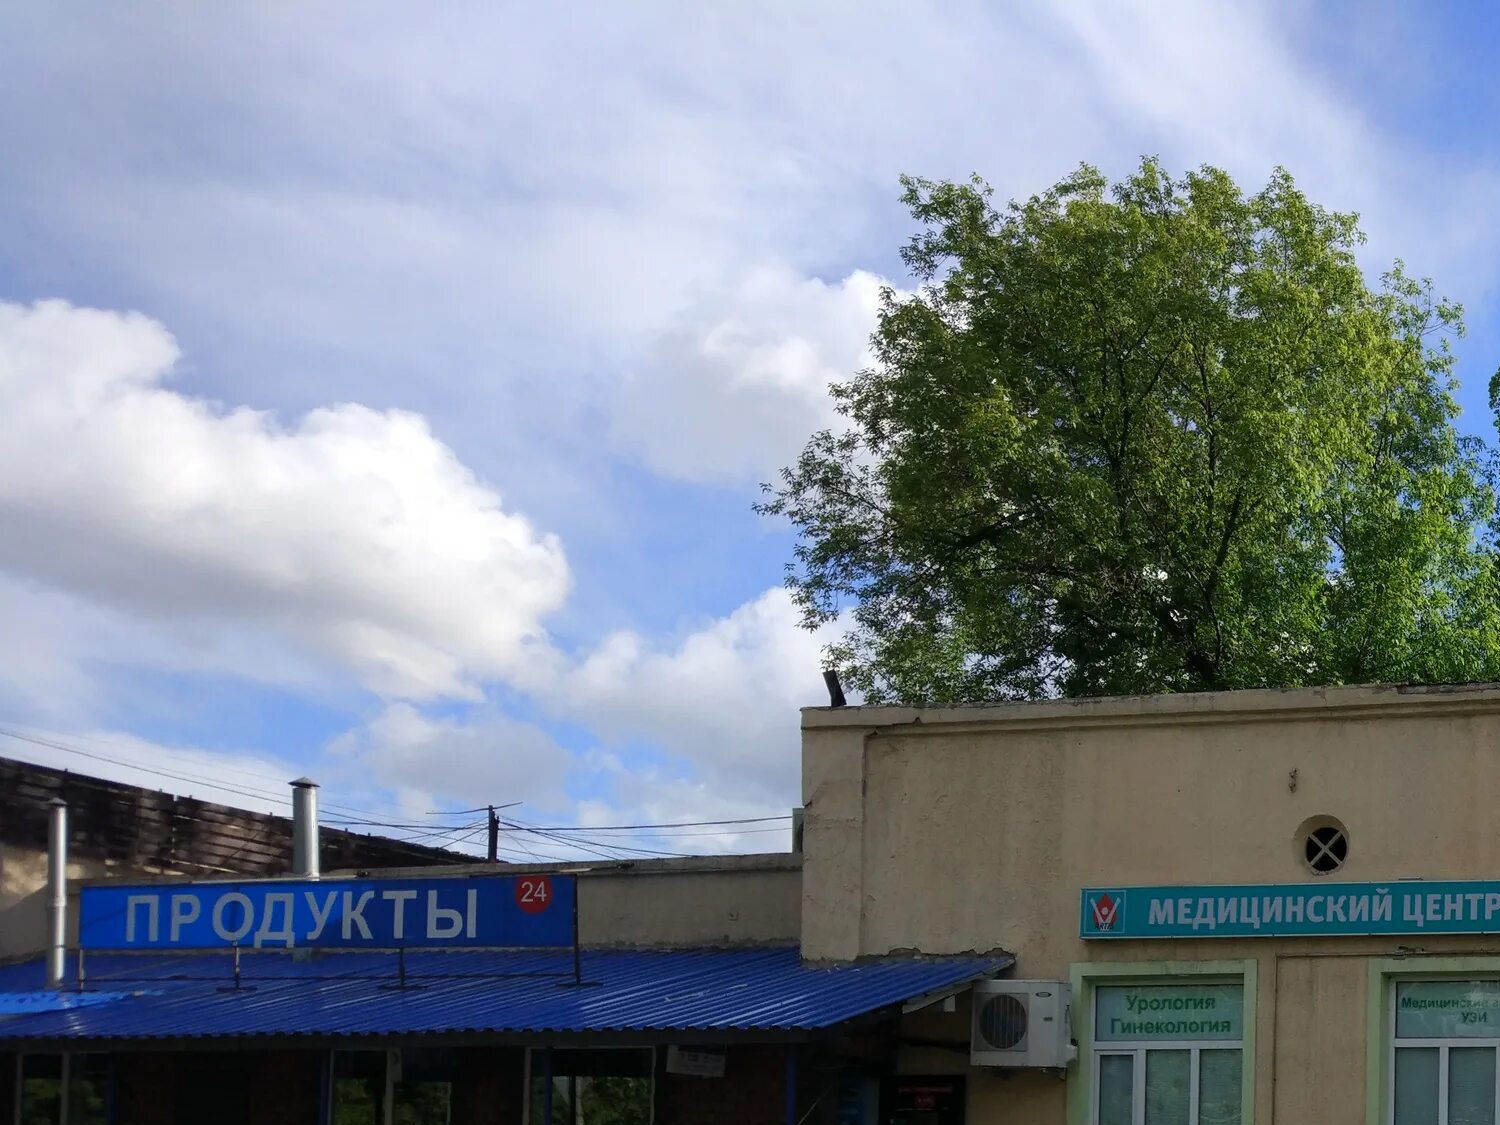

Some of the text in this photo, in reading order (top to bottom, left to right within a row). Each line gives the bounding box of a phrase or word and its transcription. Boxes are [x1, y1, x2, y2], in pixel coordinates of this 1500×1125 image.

[520, 881, 549, 904] 24
[125, 888, 478, 949] ПРОДУКТЫ
[1148, 888, 1393, 930] МЕДИЦИНСКИЙ
[1125, 994, 1216, 1015] Урология
[1110, 1018, 1231, 1035] Гинекология
[1461, 1011, 1487, 1023] УЗИ
